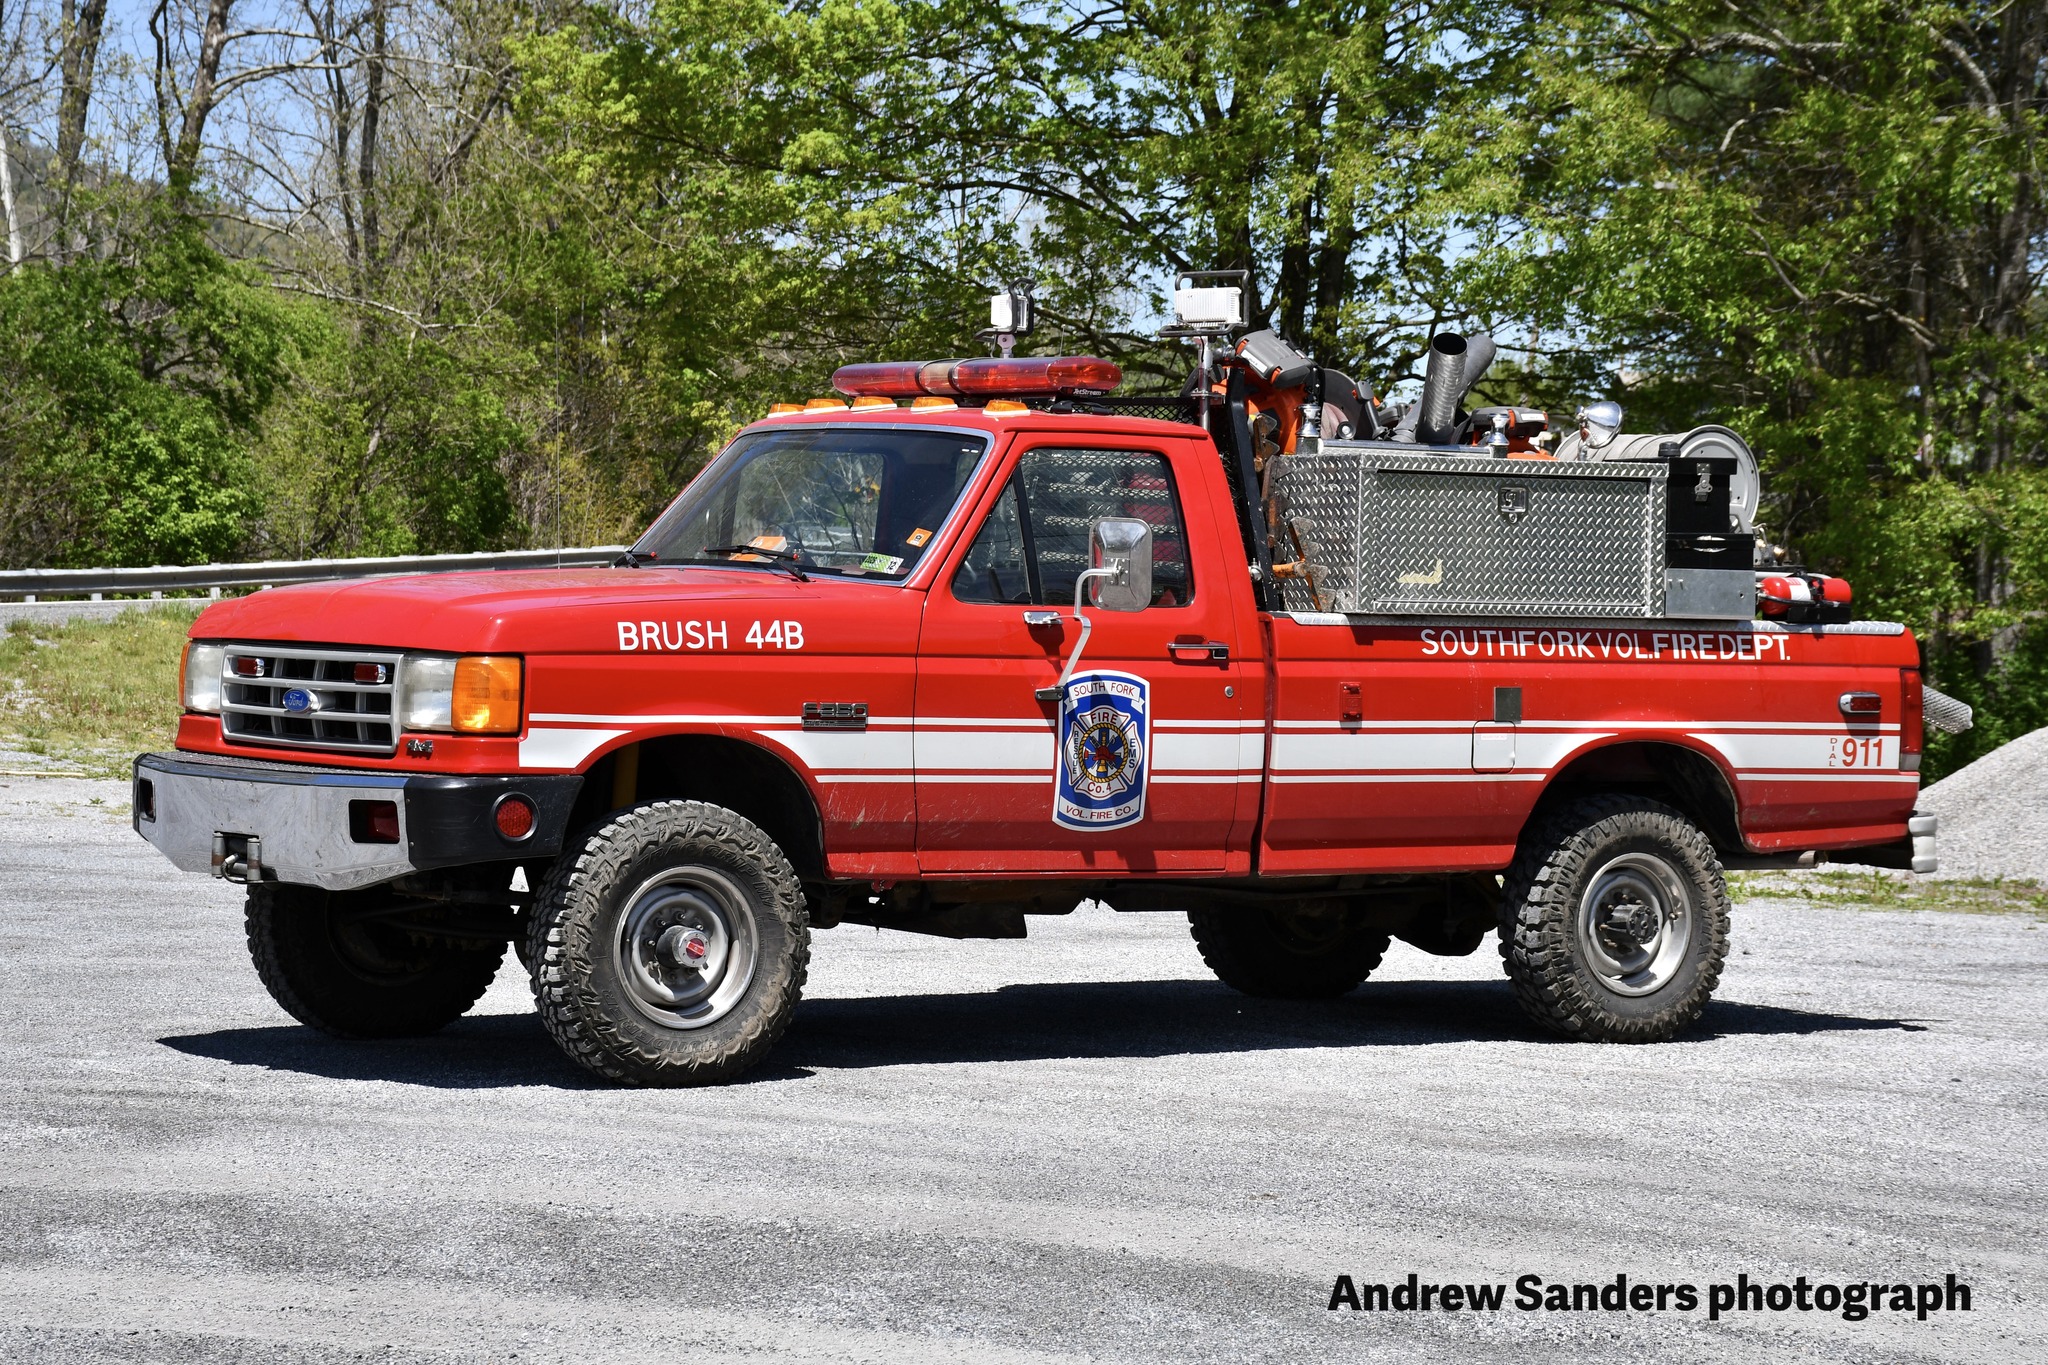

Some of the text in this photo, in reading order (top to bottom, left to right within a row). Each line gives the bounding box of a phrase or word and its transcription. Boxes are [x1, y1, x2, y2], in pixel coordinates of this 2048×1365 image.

[617, 620, 805, 651] BRUSH 44B
[1073, 682, 1136, 697] SOUTH FORK
[1091, 712, 1118, 725] FIRE
[1128, 738, 1137, 769] EMS
[1828, 737, 1883, 767] DIAL 911
[1066, 804, 1135, 820] VOL. FIRE CO.
